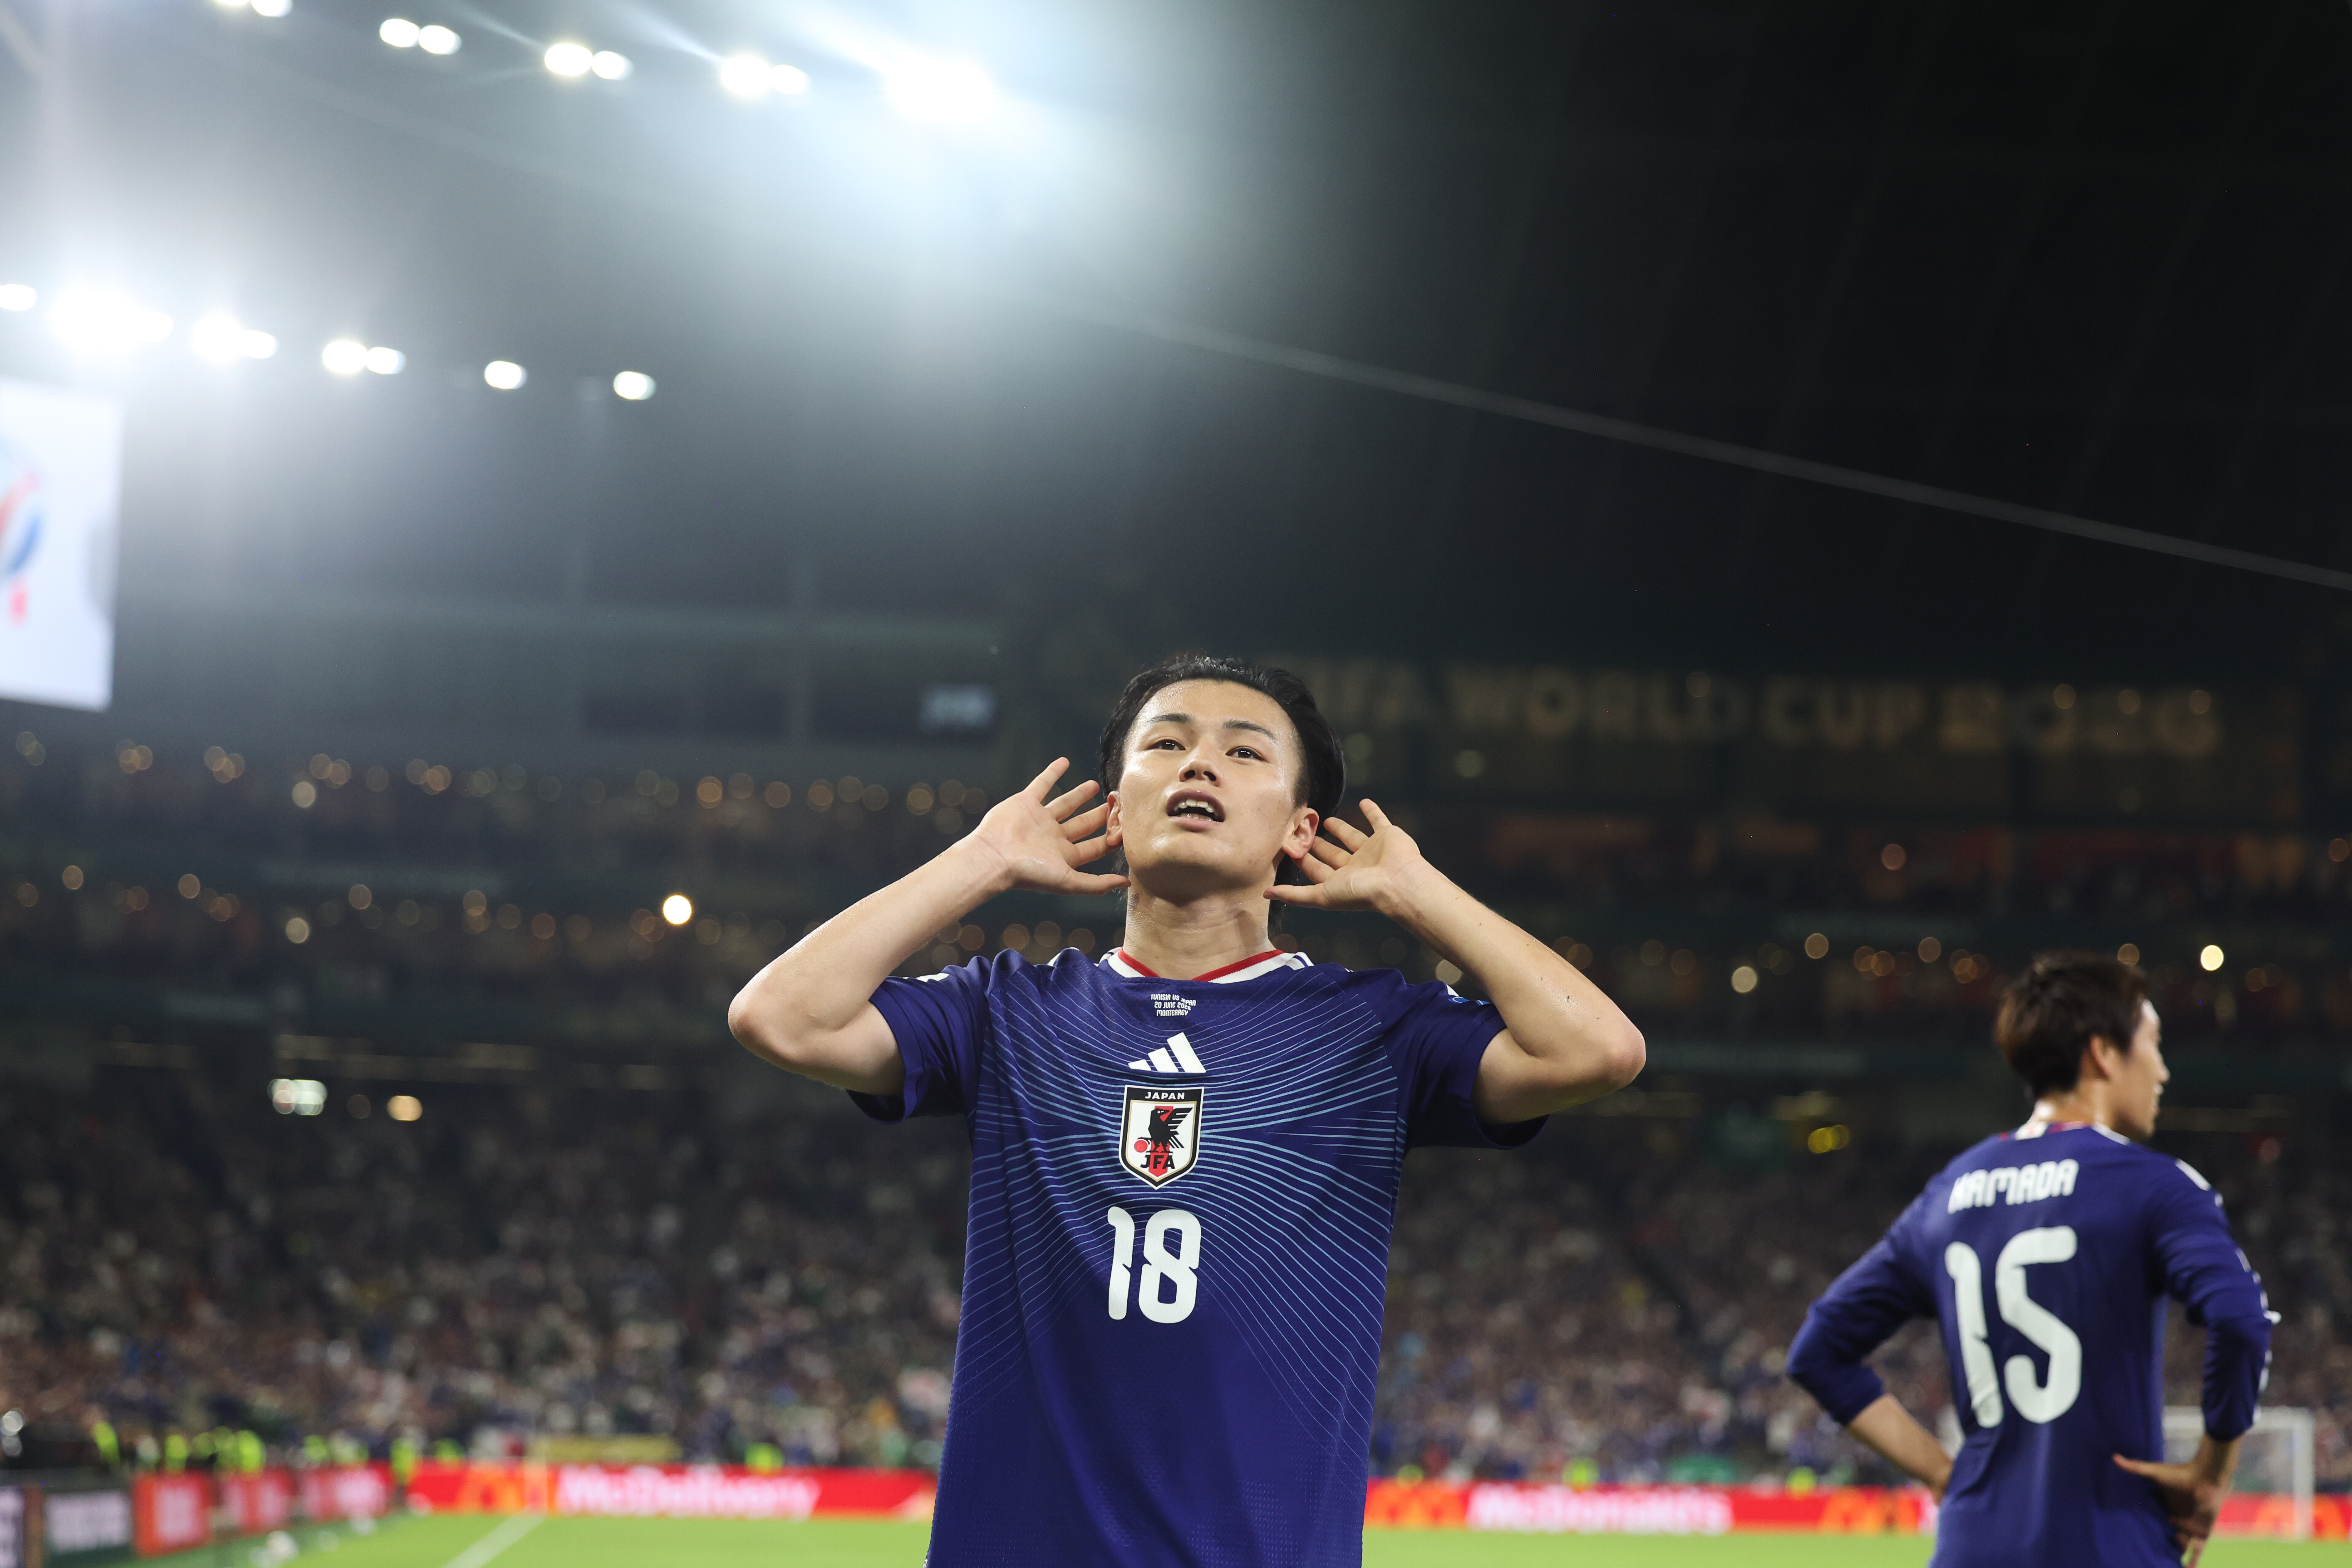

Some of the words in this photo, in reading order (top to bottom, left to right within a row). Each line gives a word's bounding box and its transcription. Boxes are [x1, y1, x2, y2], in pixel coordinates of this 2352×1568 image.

[1446, 662, 1750, 741] WORLD
[1762, 673, 1924, 749] CUP
[1177, 1002, 1191, 1010] 2026
[1181, 998, 1196, 1006] JAPAN
[1140, 1155, 1175, 1169] JFA
[1947, 1158, 2079, 1214] KAMADA
[1107, 1206, 1201, 1323] 18
[1944, 1226, 2082, 1428] 15
